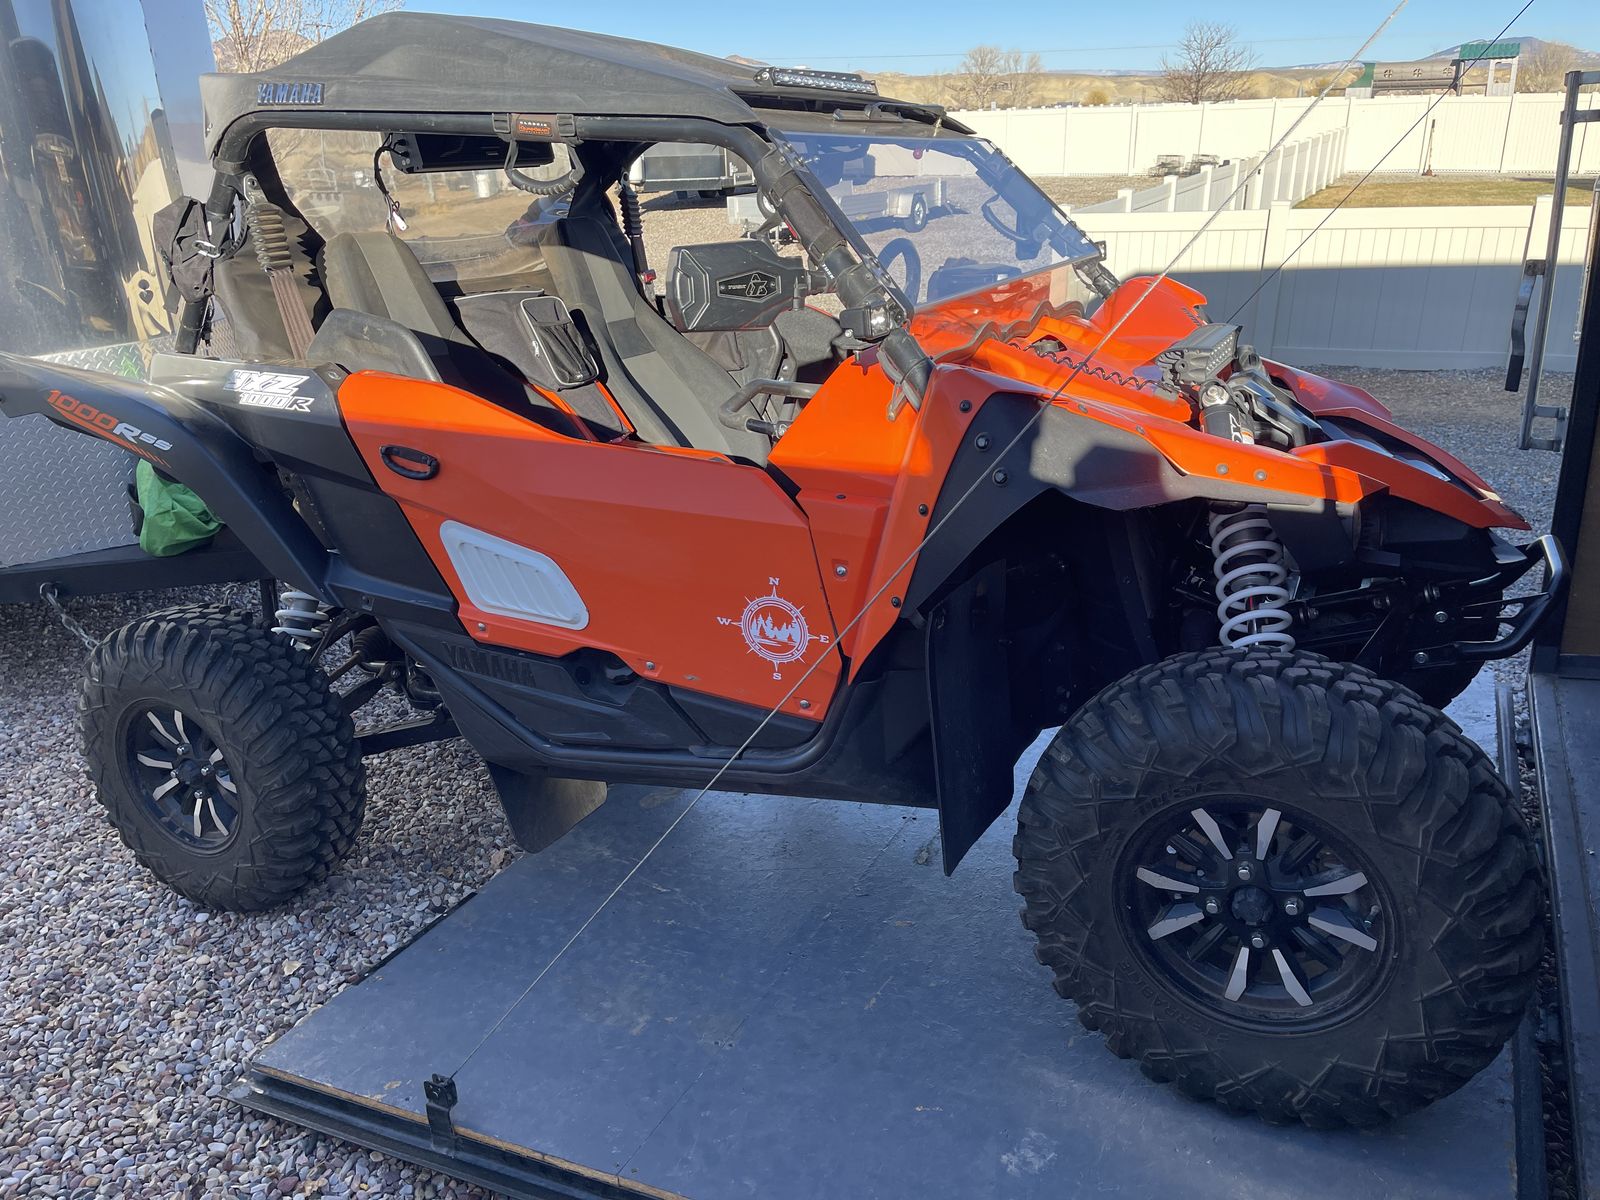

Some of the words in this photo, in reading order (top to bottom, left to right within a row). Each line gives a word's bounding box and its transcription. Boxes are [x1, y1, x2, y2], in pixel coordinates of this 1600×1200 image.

[257, 82, 323, 104] YAMAHA
[223, 369, 310, 396] YXZ
[239, 392, 315, 413] 1000R
[769, 577, 780, 586] N
[716, 616, 732, 625] W
[819, 634, 830, 644] E
[440, 640, 537, 688] YAMAHA
[772, 672, 782, 680] S
